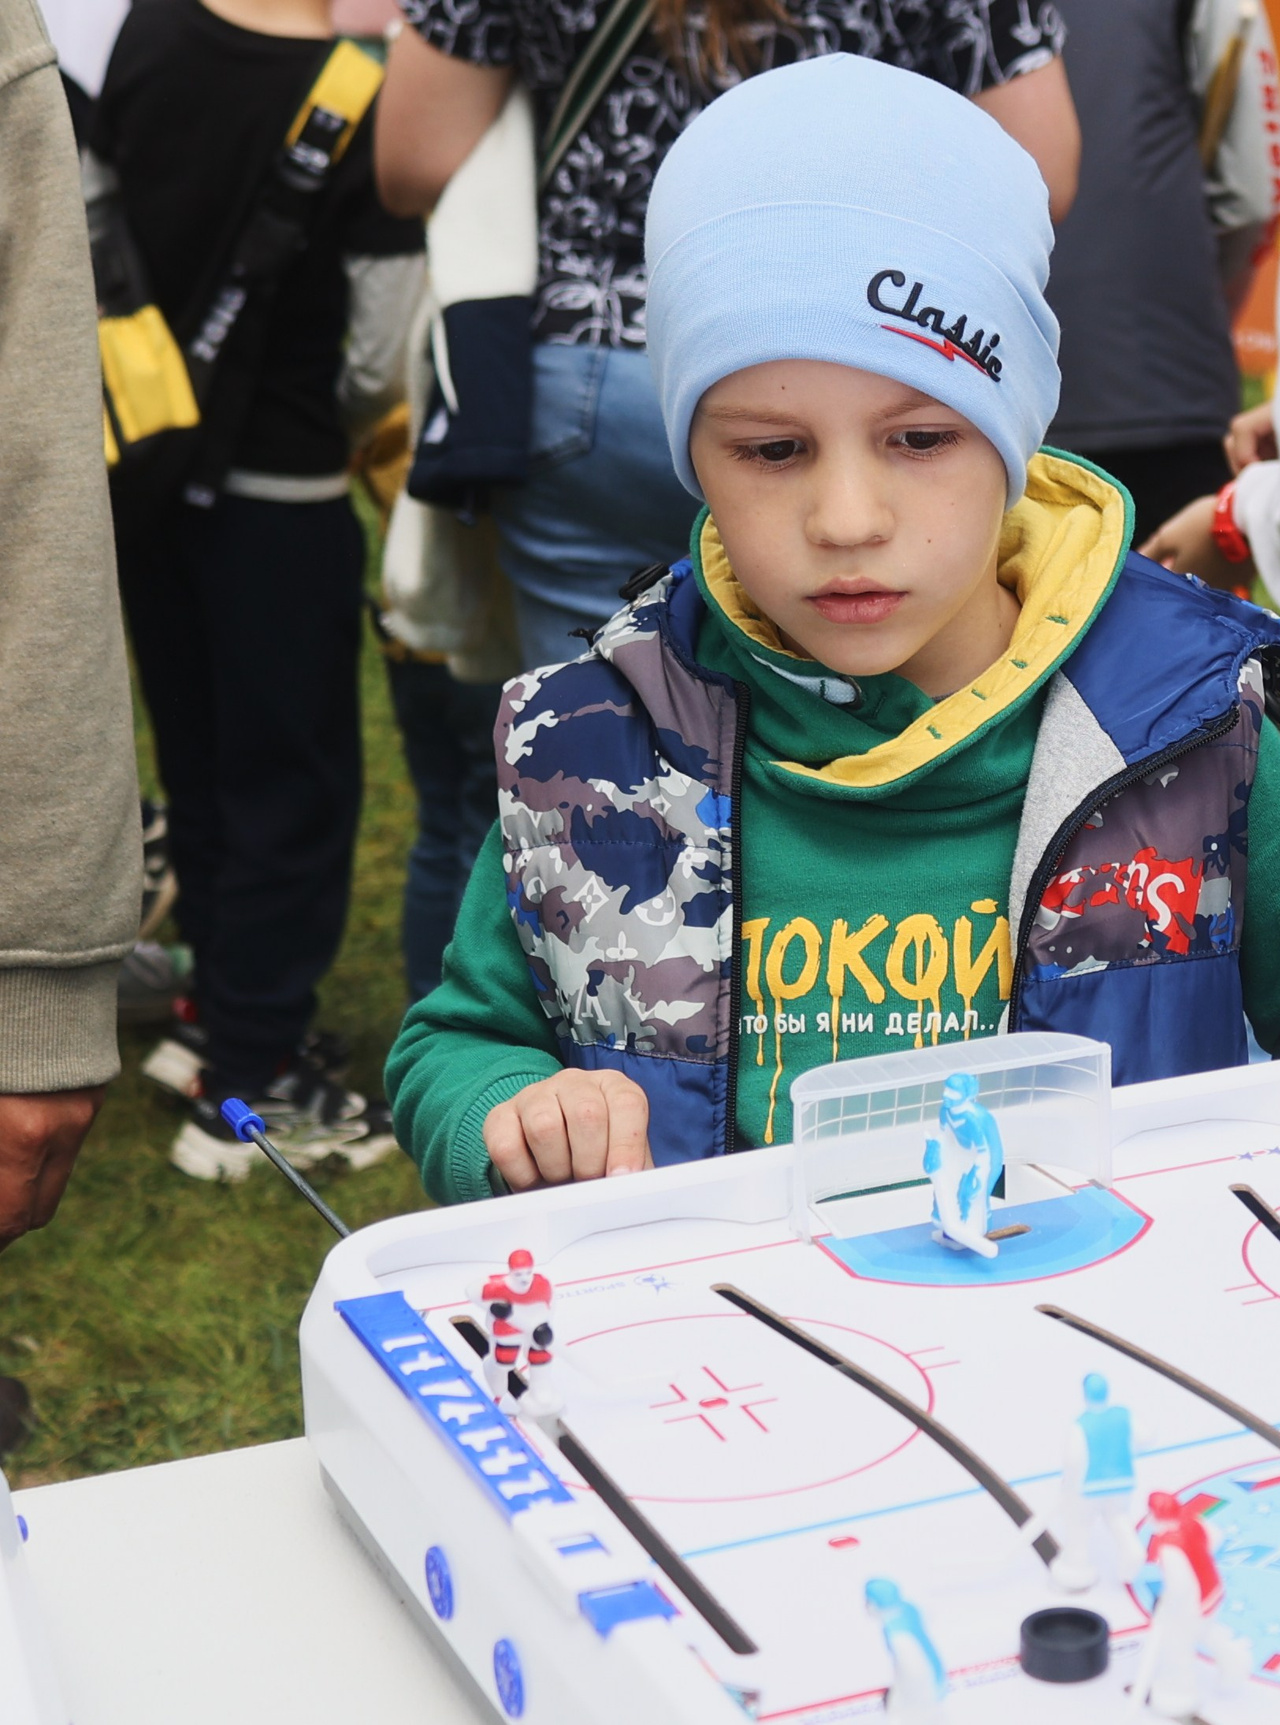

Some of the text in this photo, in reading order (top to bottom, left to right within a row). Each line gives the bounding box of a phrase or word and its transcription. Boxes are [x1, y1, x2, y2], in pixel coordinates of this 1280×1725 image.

[867, 269, 1003, 383] Classic
[739, 1014, 768, 1034] ТО
[816, 1012, 831, 1034] Я
[842, 1012, 874, 1033] НИ
